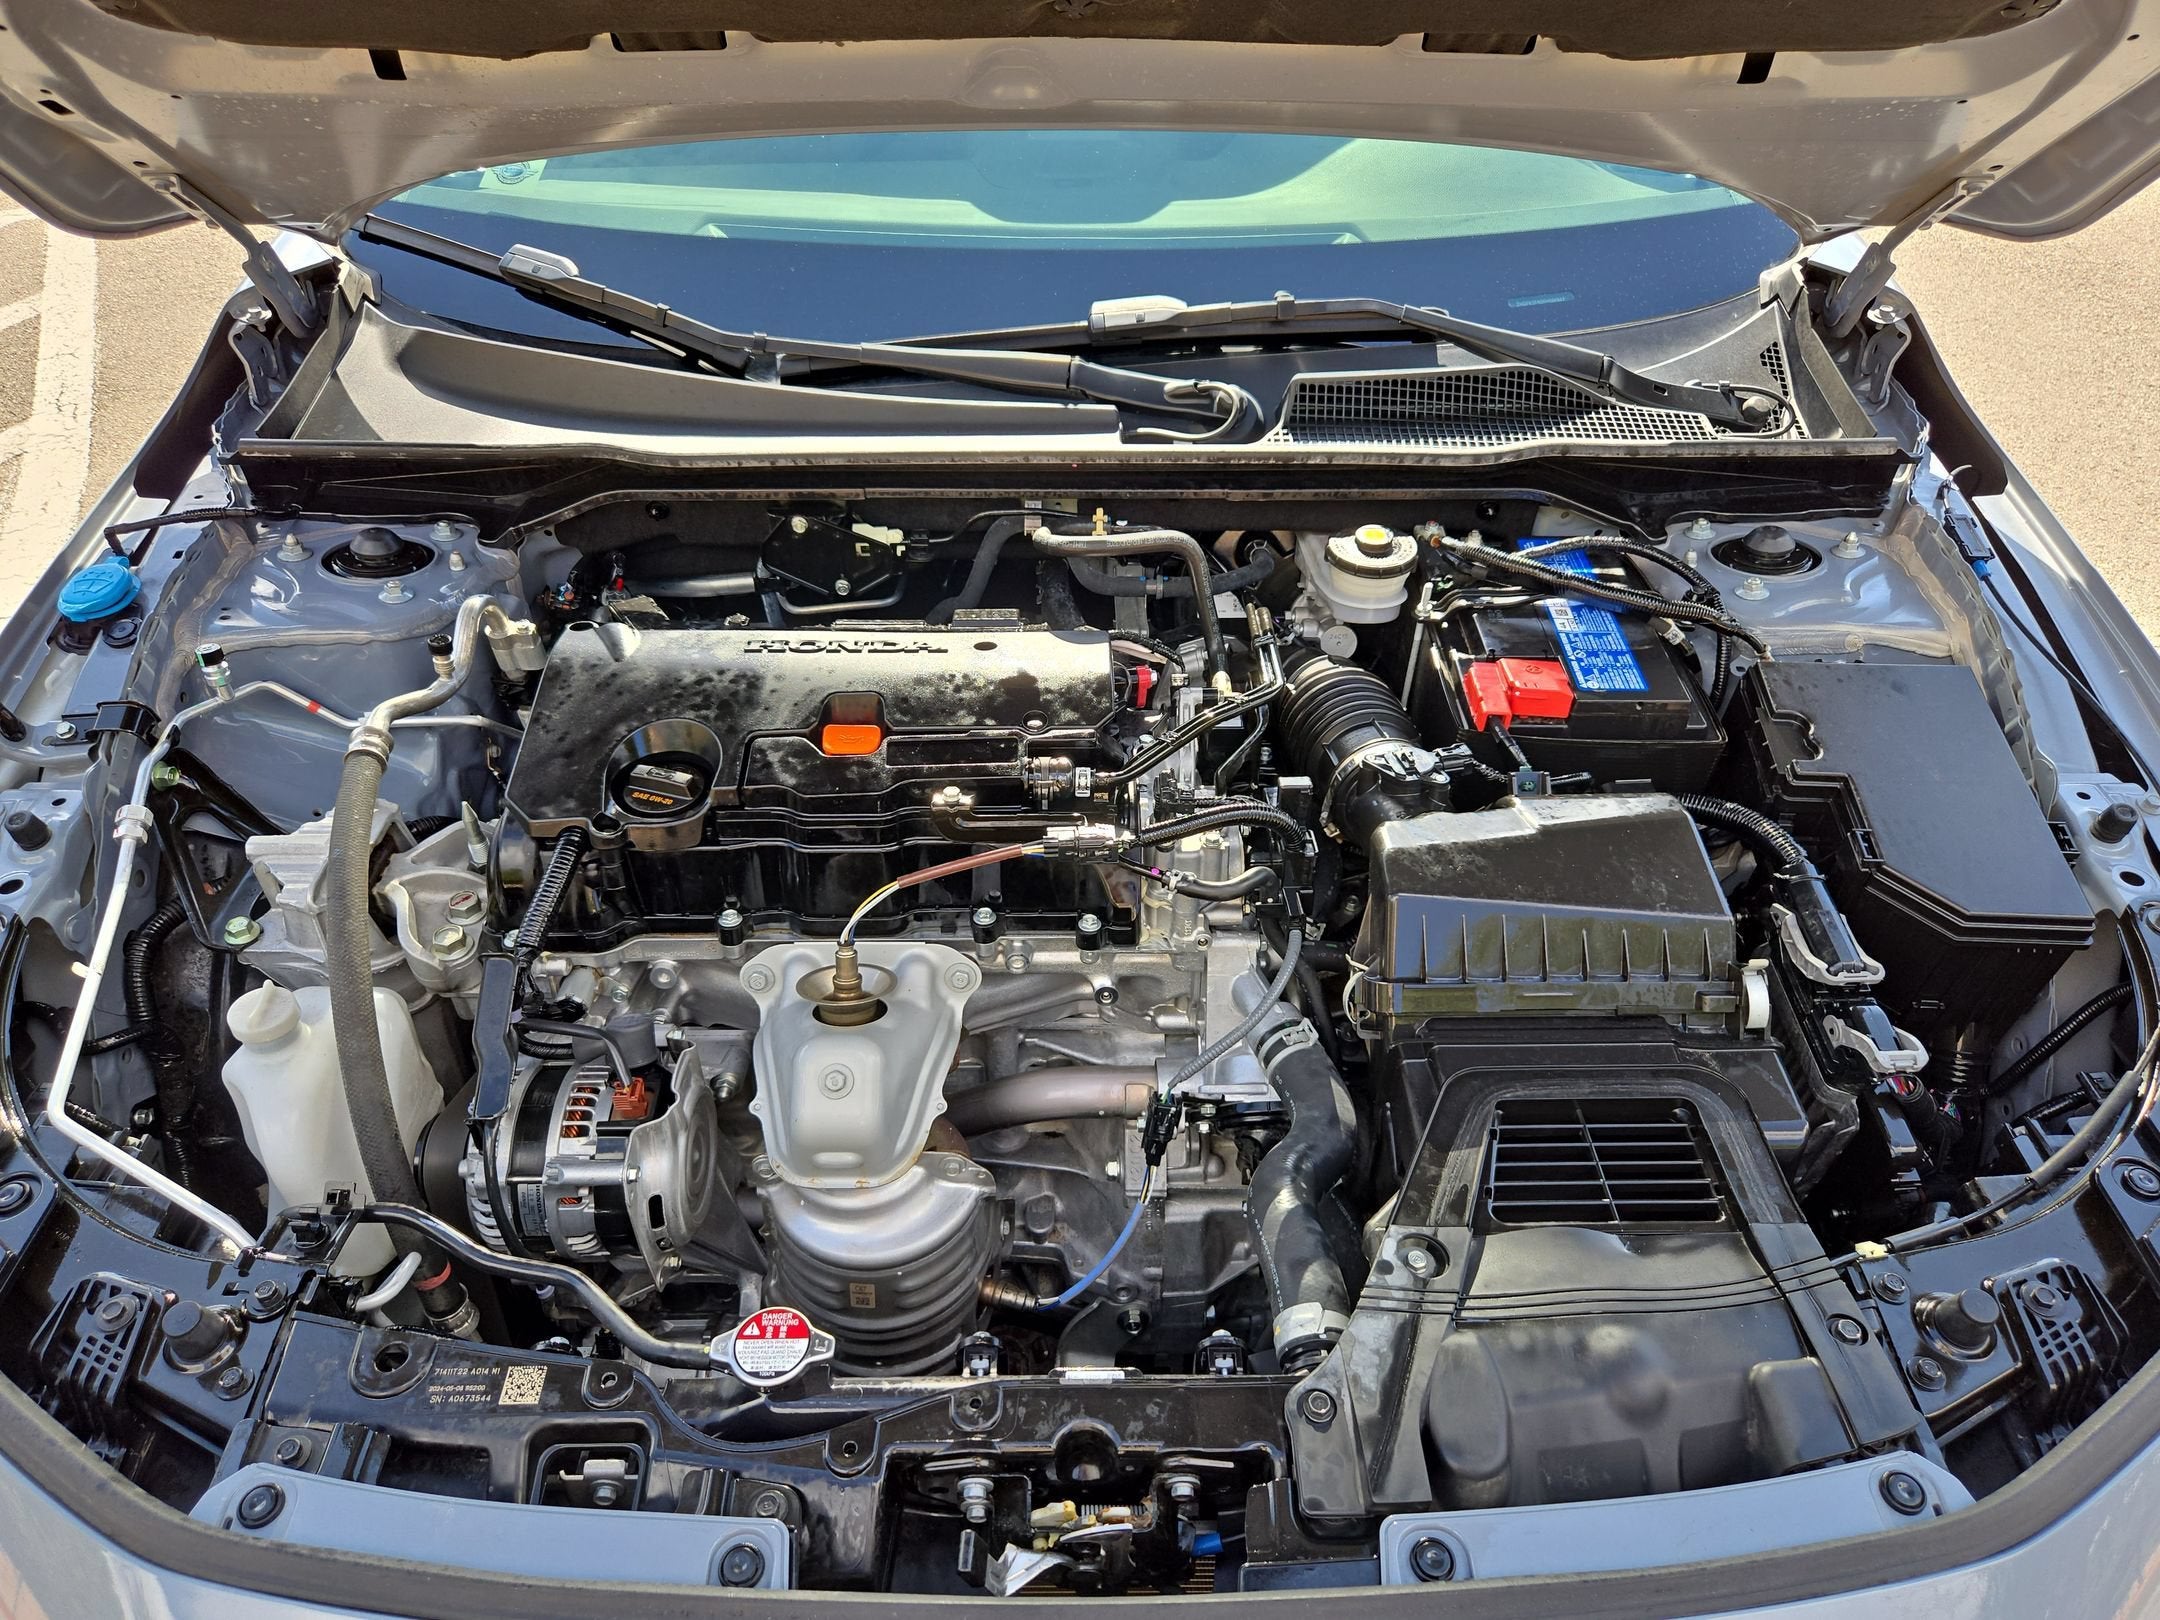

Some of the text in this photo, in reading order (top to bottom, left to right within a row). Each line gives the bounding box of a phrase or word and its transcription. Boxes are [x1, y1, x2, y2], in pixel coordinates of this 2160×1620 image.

[744, 639, 949, 654] HONDA
[631, 791, 674, 805] SAE 0W-20
[761, 1312, 793, 1320] DANGER
[429, 1394, 491, 1403] SN: A0673544
